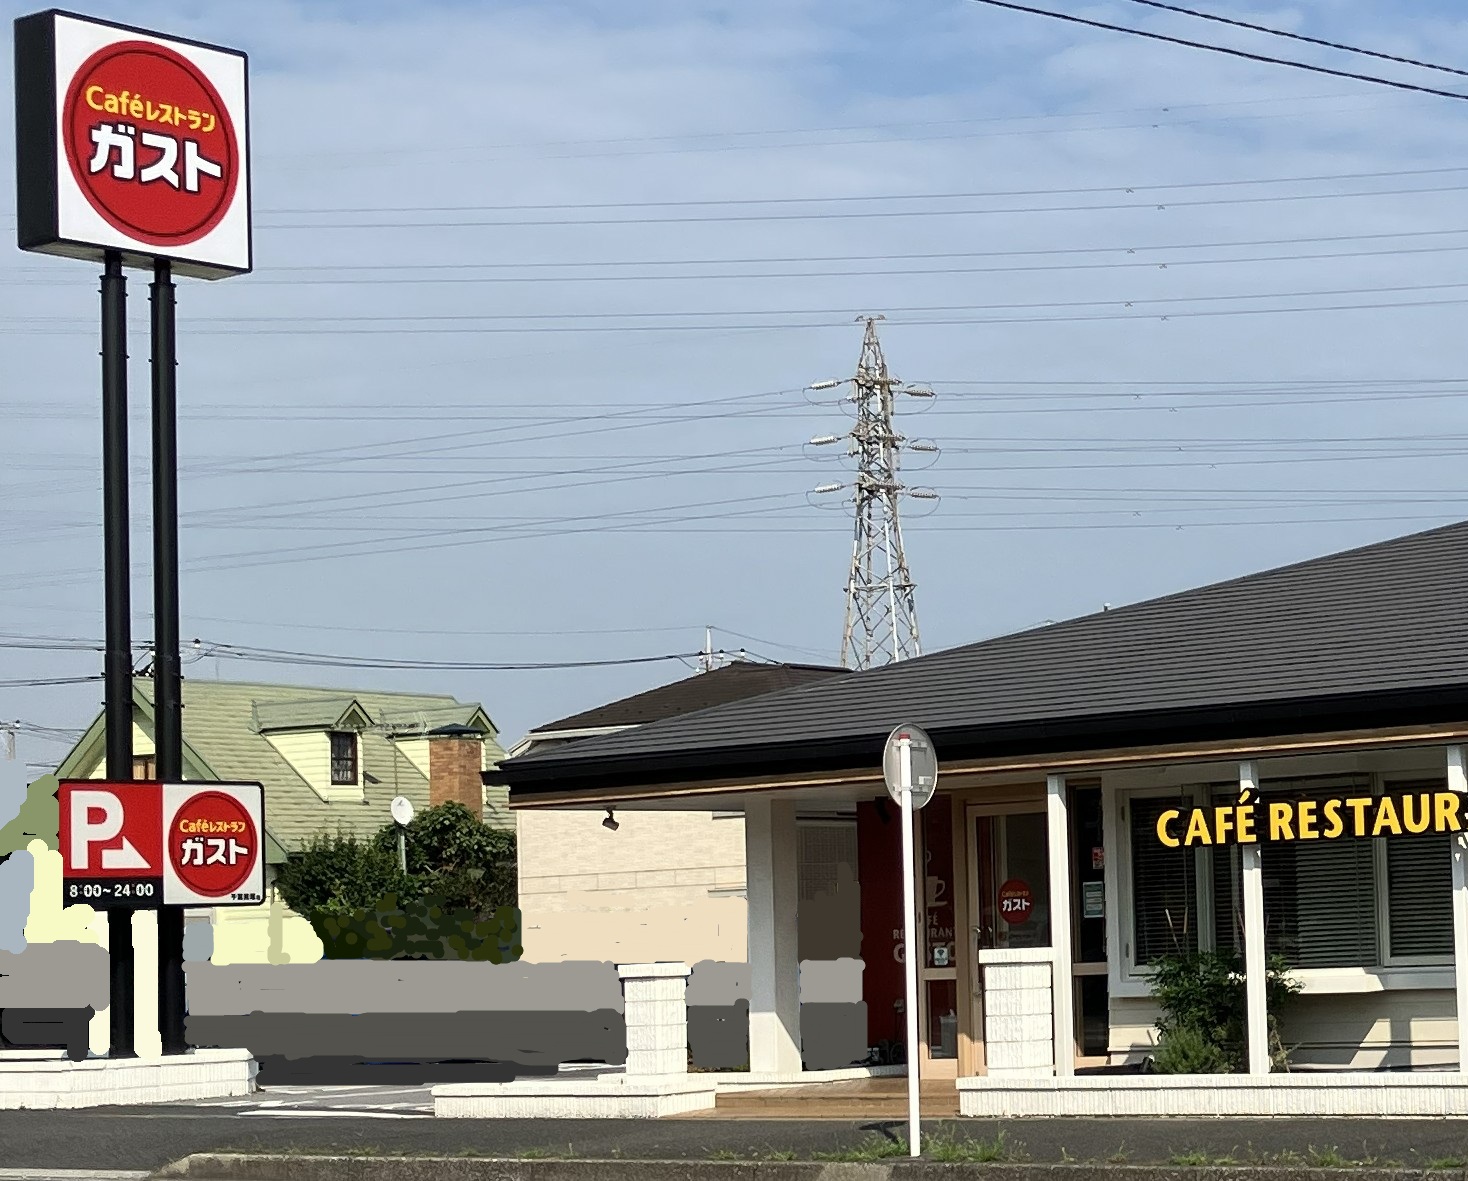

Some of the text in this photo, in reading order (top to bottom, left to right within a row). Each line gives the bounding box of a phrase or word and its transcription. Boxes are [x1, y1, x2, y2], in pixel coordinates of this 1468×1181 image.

[85, 85, 216, 133] Caféレストラン
[90, 123, 222, 192] ガスト
[70, 790, 125, 870] P
[1156, 790, 1257, 847] CAFÉ
[181, 837, 249, 865] ガスト
